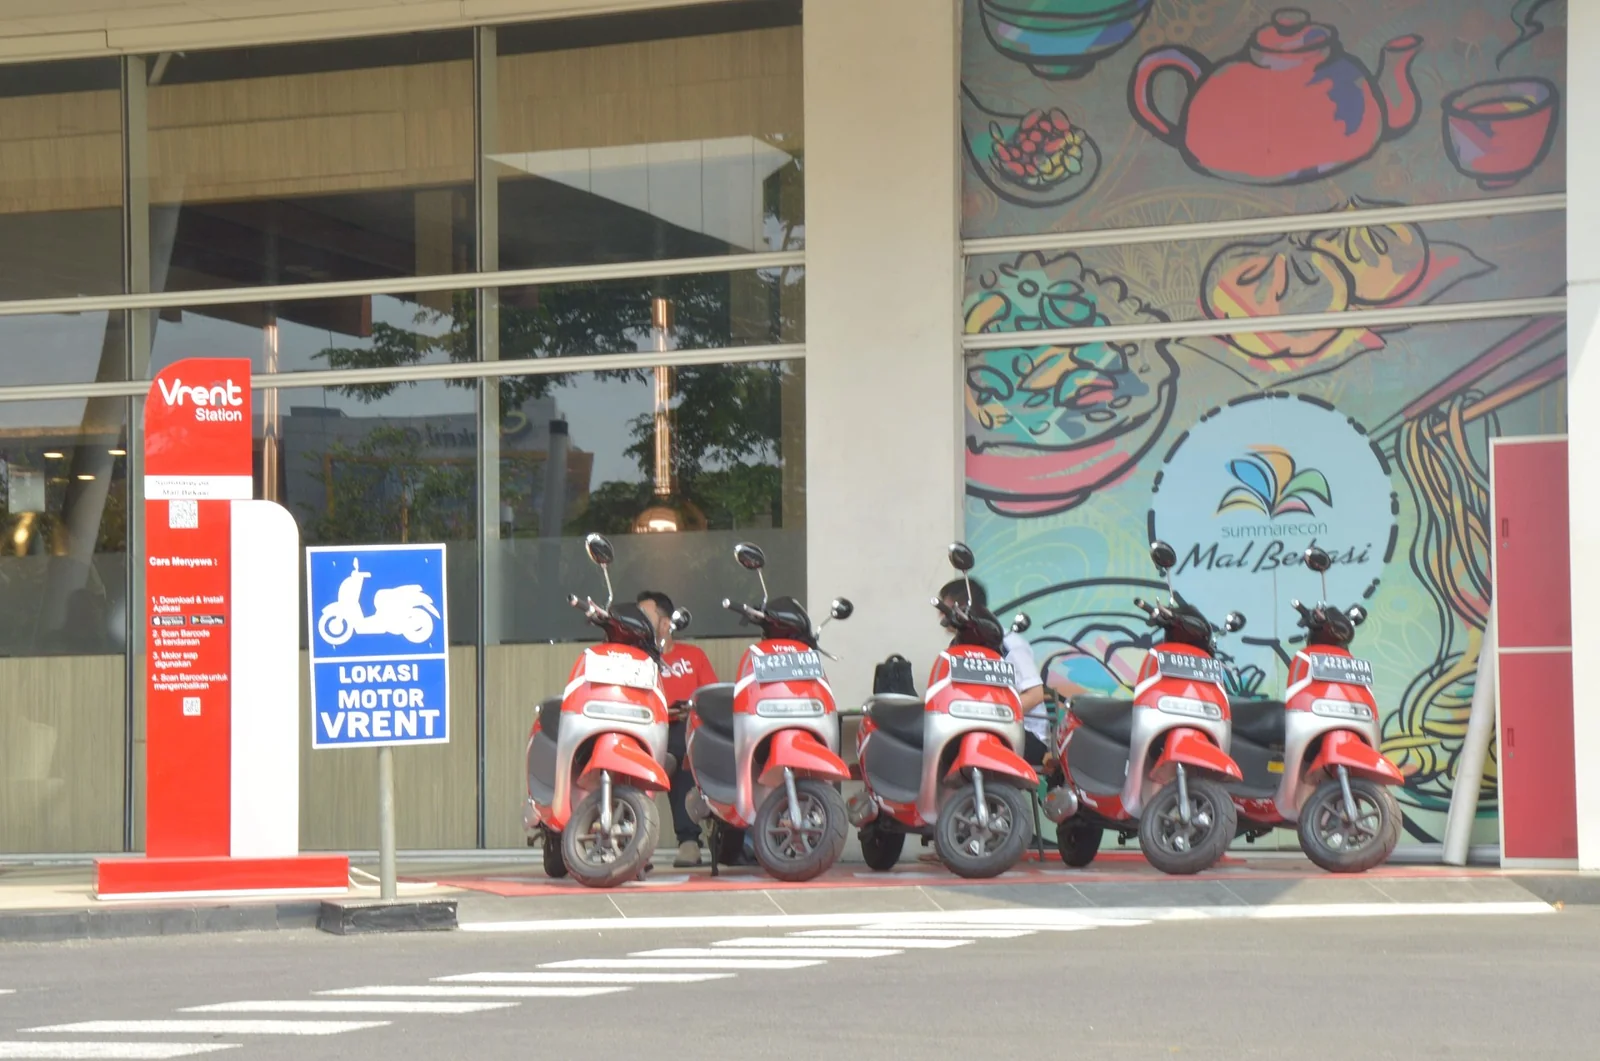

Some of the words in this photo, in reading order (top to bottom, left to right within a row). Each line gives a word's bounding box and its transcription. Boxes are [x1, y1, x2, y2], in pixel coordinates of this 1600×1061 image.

[158, 378, 243, 406] Vrent
[195, 408, 242, 422] Station
[1221, 521, 1328, 539] summarecon
[149, 556, 170, 566] Cara
[172, 556, 212, 568] Menyewa
[1175, 540, 1254, 575] Mal
[160, 596, 194, 604] Download
[204, 596, 224, 604] Install
[153, 604, 180, 614] Aplikasi
[161, 630, 179, 638] Scan
[181, 630, 210, 638] Barcode
[180, 673, 208, 682] Barcode
[339, 664, 418, 684] LOKASI
[338, 688, 424, 709] MOTOR
[320, 709, 440, 739] VRENT
